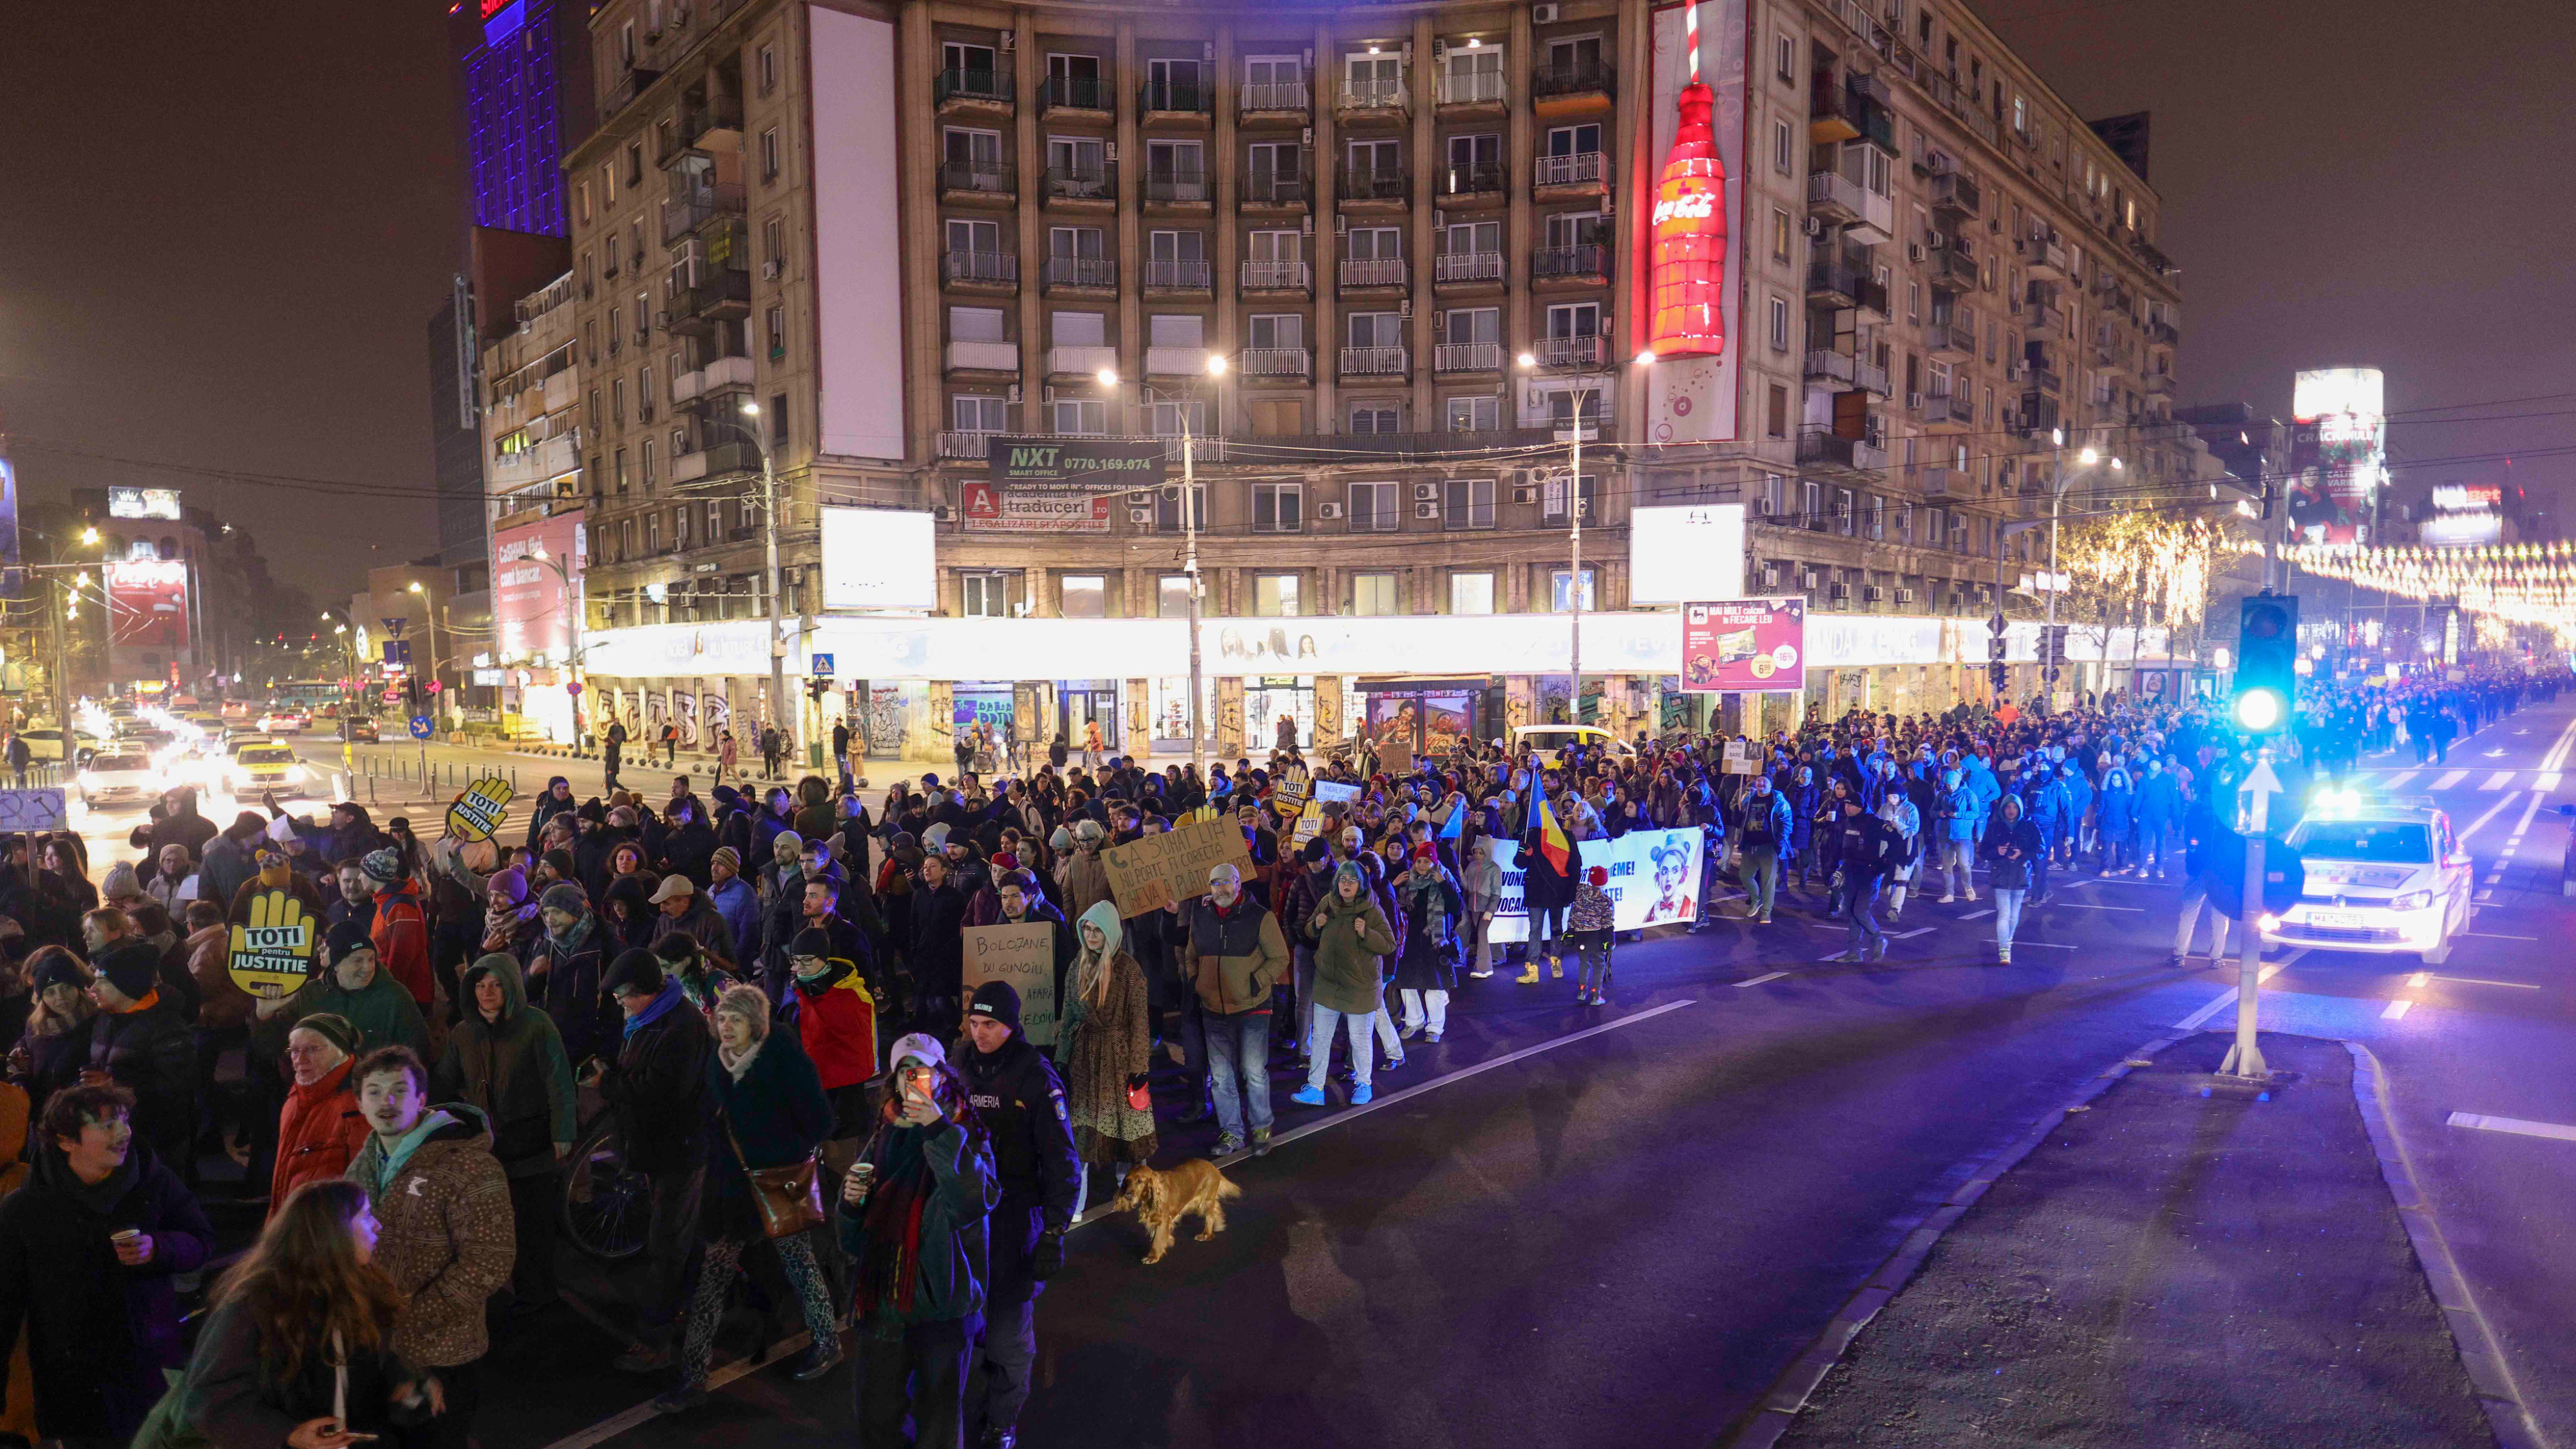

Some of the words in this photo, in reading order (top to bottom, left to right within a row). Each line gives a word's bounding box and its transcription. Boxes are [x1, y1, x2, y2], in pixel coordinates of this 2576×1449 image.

[1010, 448, 1059, 467] NXT
[1064, 458, 1150, 470] 0770.169.074
[1007, 500, 1085, 513] traduceri
[1052, 520, 1104, 529] APOSTILE
[1709, 607, 1722, 615] MAI
[1724, 606, 1742, 615] MULT
[1759, 614, 1772, 623] LEU
[1134, 861, 1164, 883] POATE
[1163, 878, 1175, 898] A
[247, 927, 299, 946] TOȚI
[233, 954, 308, 972] JUSTIȚIE
[983, 962, 994, 973] DU
[1027, 986, 1054, 1000] AFARĂ
[969, 1095, 1000, 1108] ARMERIA
